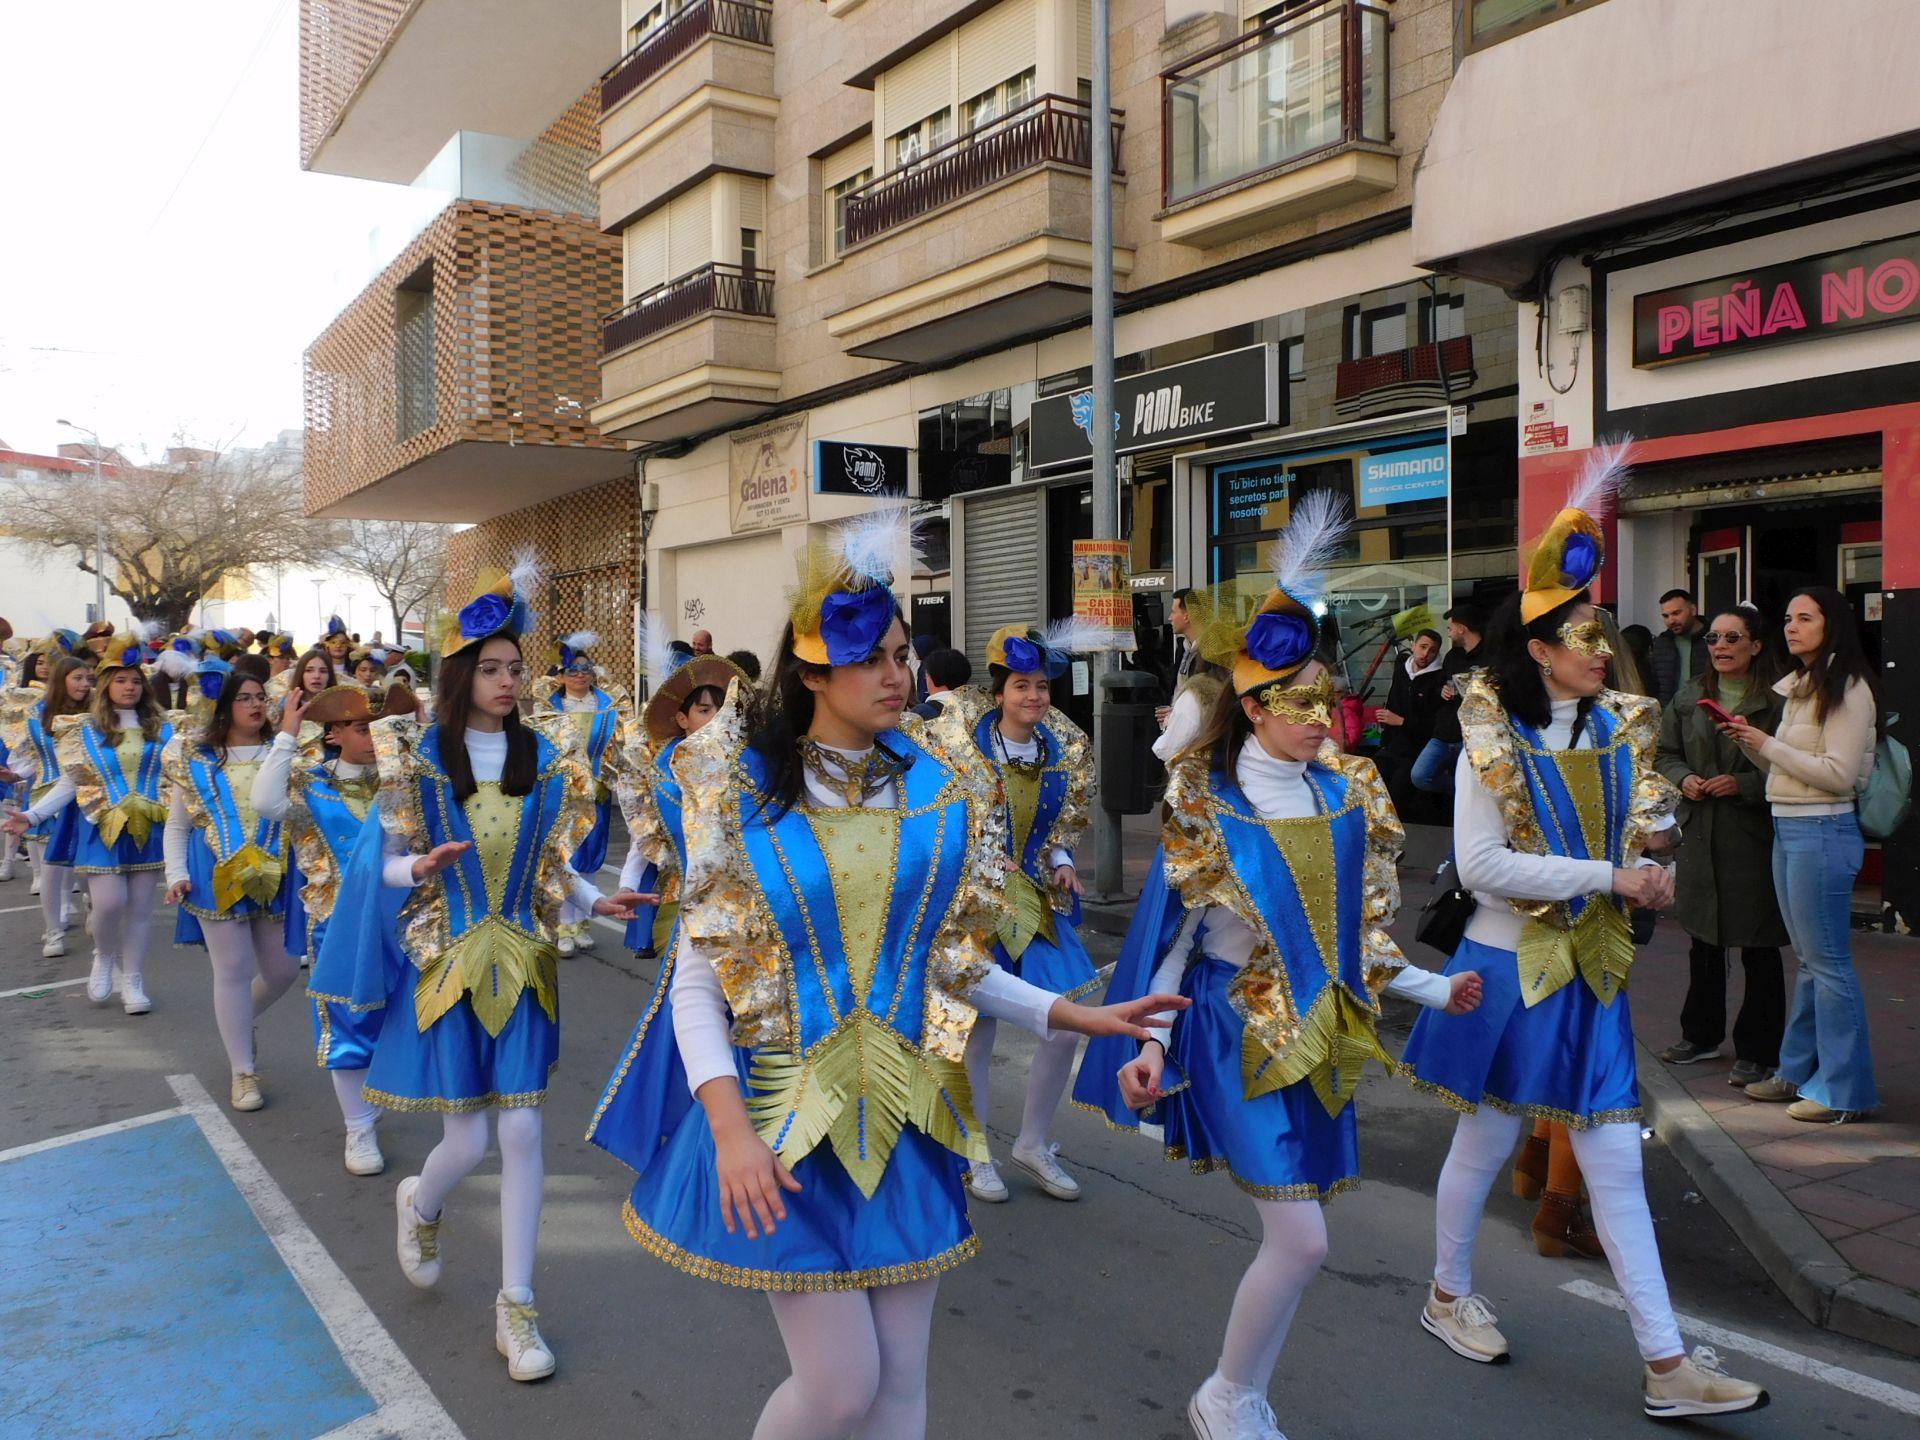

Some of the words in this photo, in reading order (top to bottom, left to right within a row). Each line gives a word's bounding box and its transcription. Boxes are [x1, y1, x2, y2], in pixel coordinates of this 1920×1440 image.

[1657, 280, 1807, 354] PEÑA
[1821, 258, 1920, 324] NO
[1179, 401, 1215, 428] BIKE
[1368, 456, 1444, 480] SHIMANO
[741, 475, 787, 502] Galena
[789, 468, 797, 492] 3
[1229, 479, 1240, 490] Tu
[1241, 476, 1258, 489] bici
[1260, 477, 1271, 486] no
[1273, 472, 1297, 484] tiene
[1368, 483, 1403, 494] SERVICE
[1404, 480, 1444, 490] CENTER
[1229, 491, 1267, 504] secretos
[1269, 489, 1289, 501] para
[1229, 506, 1268, 519] nosotros
[1130, 576, 1166, 587] TREK
[917, 596, 944, 605] TREK
[1089, 599, 1131, 608] CASTELLA
